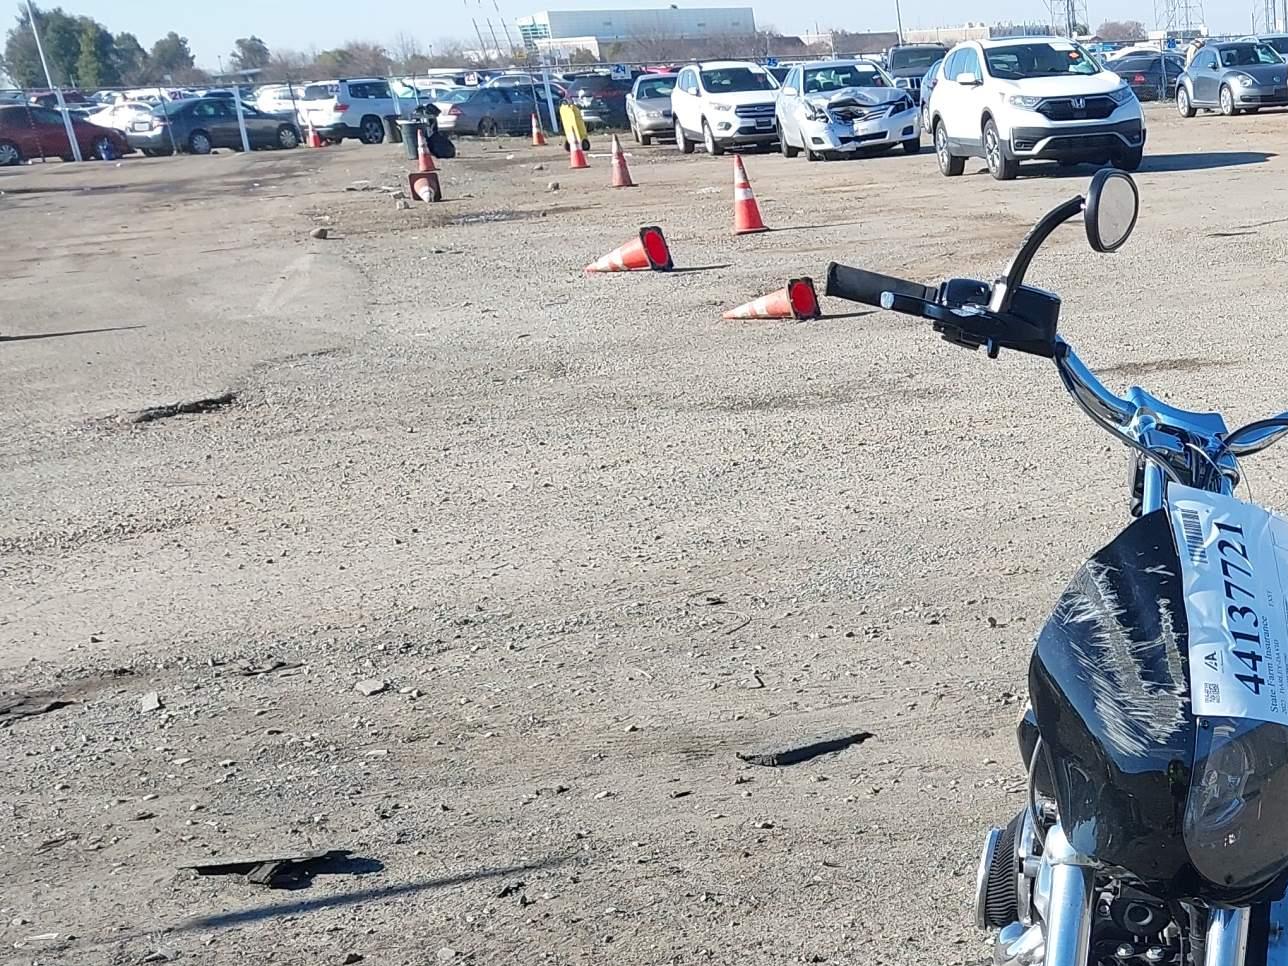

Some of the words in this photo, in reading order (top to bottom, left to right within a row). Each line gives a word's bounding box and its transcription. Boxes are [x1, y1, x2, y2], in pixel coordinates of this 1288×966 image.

[170, 91, 182, 100] 21
[328, 84, 340, 93] 22
[1214, 521, 1265, 695] 44137721
[1261, 616, 1273, 659] Insurance
[1267, 663, 1276, 687] Farm
[1269, 690, 1279, 713] State
